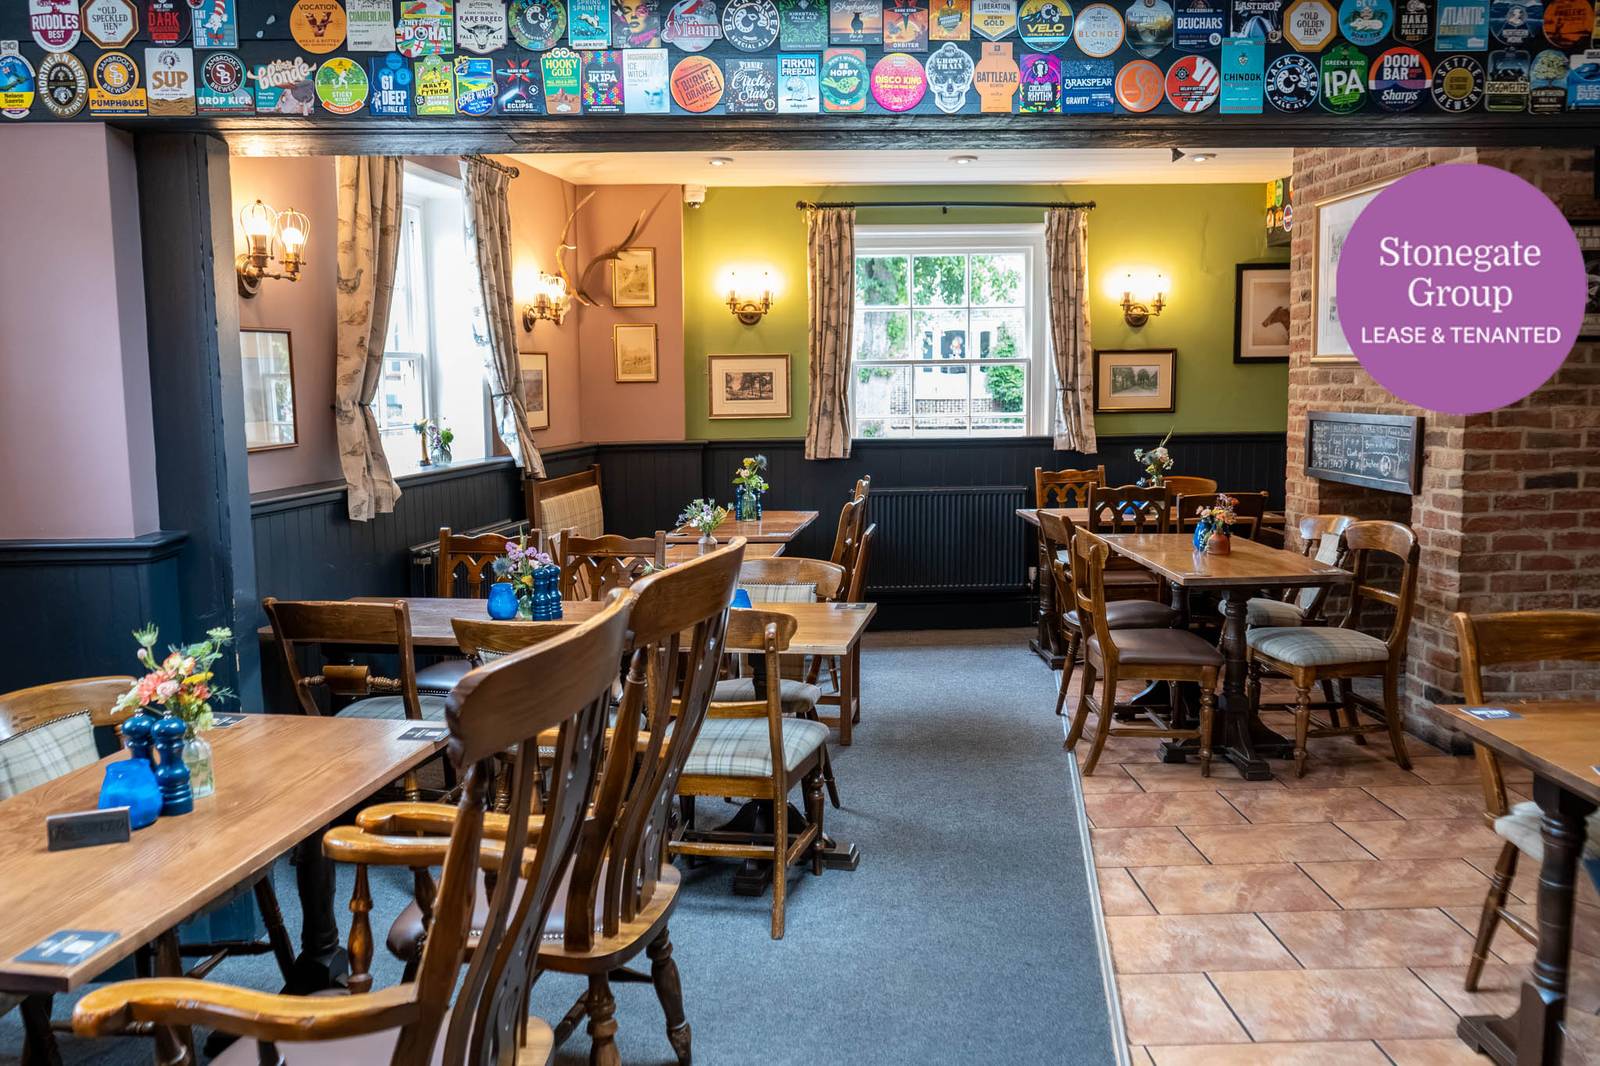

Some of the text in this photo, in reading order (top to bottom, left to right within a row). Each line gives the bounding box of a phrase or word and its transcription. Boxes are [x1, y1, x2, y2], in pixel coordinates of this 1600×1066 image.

[978, 3, 1011, 11] LIBERATION
[92, 14, 128, 22] SPECKLED
[148, 12, 180, 26] DARK
[349, 11, 391, 22] CUMBERLAND
[725, 0, 776, 35] BLACK SHEEP
[1402, 15, 1428, 24] HAKA
[1440, 6, 1485, 25] ATLANTIC
[32, 14, 79, 31] RUDDLES
[1027, 23, 1065, 32] VELO
[1177, 17, 1223, 30] DEUCHARS
[1296, 19, 1325, 28] GOLDEN
[48, 31, 65, 39] BEST
[404, 26, 452, 41] DOHA!
[1078, 30, 1120, 38] BLONDE
[731, 34, 769, 49] SPECIAL ALE
[98, 55, 133, 72] SAMBROOK'S
[205, 55, 240, 71] SAMBROOK'S
[546, 59, 578, 69] HOOKY
[627, 62, 637, 70] ICE
[781, 58, 815, 68] FIRKIN
[1384, 55, 1420, 68] DOOM
[1438, 58, 1481, 77] SETTLE
[39, 54, 68, 94] NORTHERN
[70, 60, 86, 94] RISING
[258, 56, 310, 89] blonde
[551, 68, 572, 77] GOLD
[600, 74, 618, 82] IPA
[627, 70, 648, 78] WITCH
[781, 68, 816, 76] FREEZIN
[830, 69, 859, 77] HOPPY
[976, 71, 1018, 83] BATTLEAXE
[1223, 73, 1262, 81] CHINOOK
[1266, 58, 1317, 97] BLACK SHEEP
[1383, 68, 1409, 80] BAR
[152, 70, 188, 90] SUP
[381, 75, 393, 90] 61
[732, 70, 766, 89] Circle
[876, 76, 922, 84] DISCO KING
[1064, 78, 1112, 90] BRAKSPEAR
[1325, 69, 1365, 98] IPA
[102, 82, 132, 95] BREWERY
[210, 81, 239, 94] BREWERY
[477, 85, 495, 99] WATER
[685, 80, 716, 101] ORANGE
[738, 87, 769, 101] Stars
[91, 99, 144, 107] PUMPHOUSE
[198, 96, 225, 105] DROP
[228, 96, 252, 105] KICK
[381, 90, 407, 105] DEEP
[1027, 91, 1053, 102] RHYTHM
[1066, 96, 1090, 105] GRAVITY
[1273, 96, 1308, 109] PALE ALE
[1434, 85, 1482, 110] BREWERY
